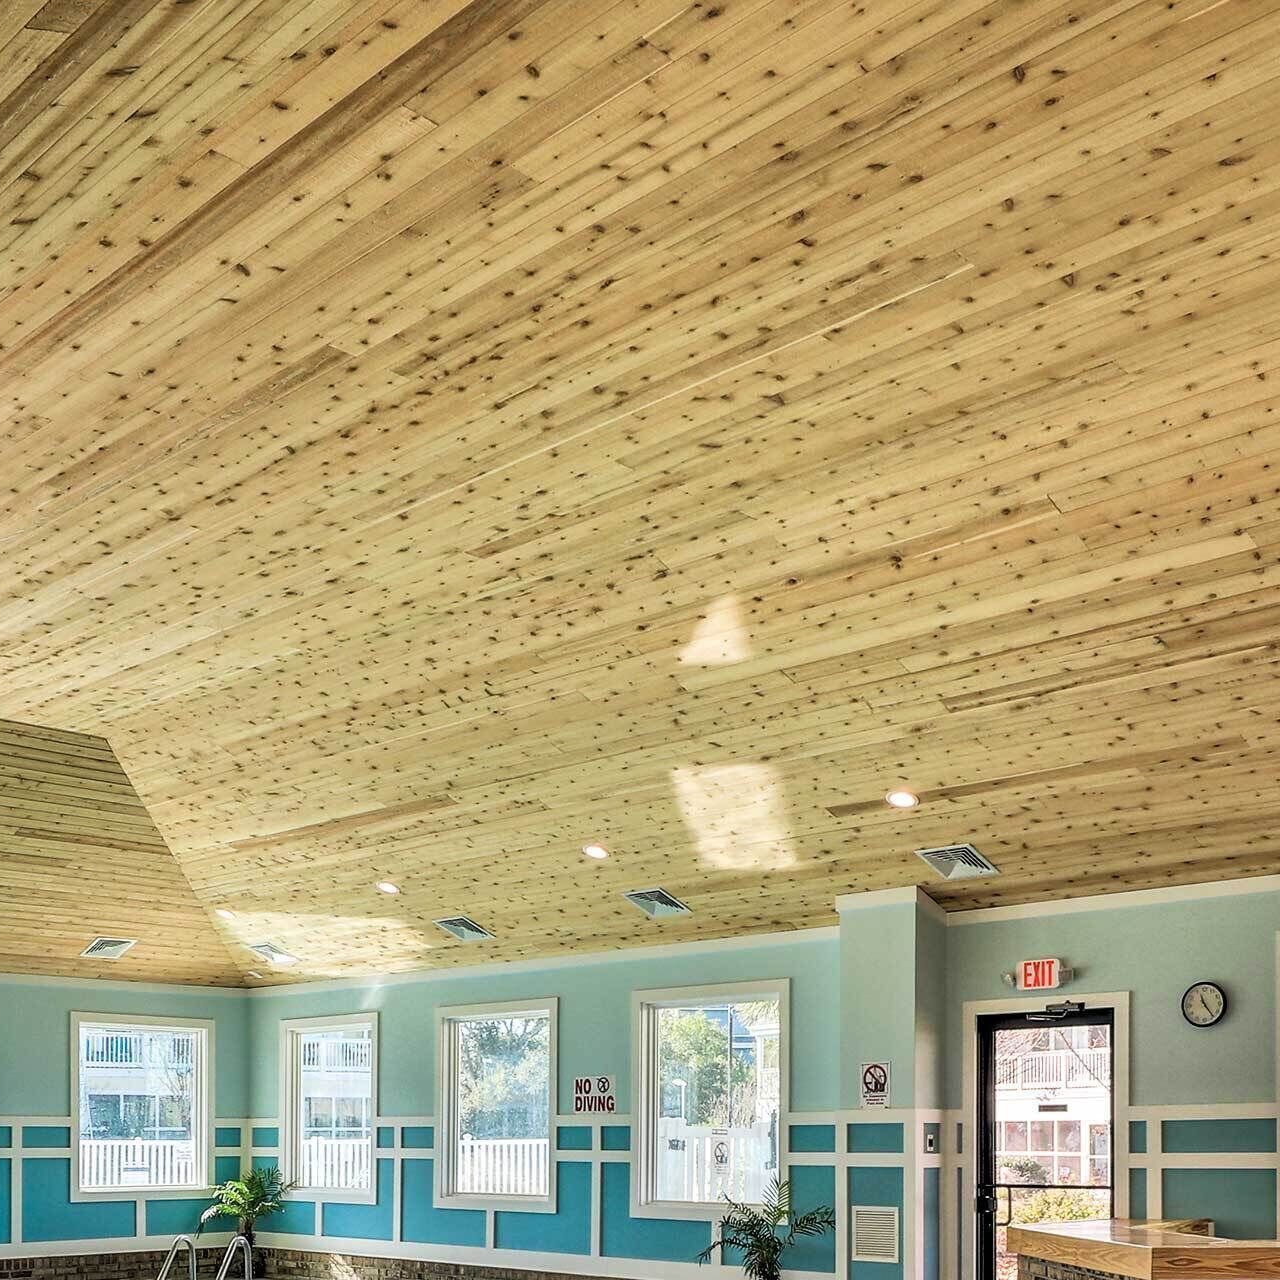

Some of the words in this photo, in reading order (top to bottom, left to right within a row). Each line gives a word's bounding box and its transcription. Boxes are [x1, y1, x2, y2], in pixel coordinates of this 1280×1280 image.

[1023, 960, 1055, 988] EXIT
[575, 1079, 591, 1094] NO
[575, 1096, 615, 1112] DIVING
